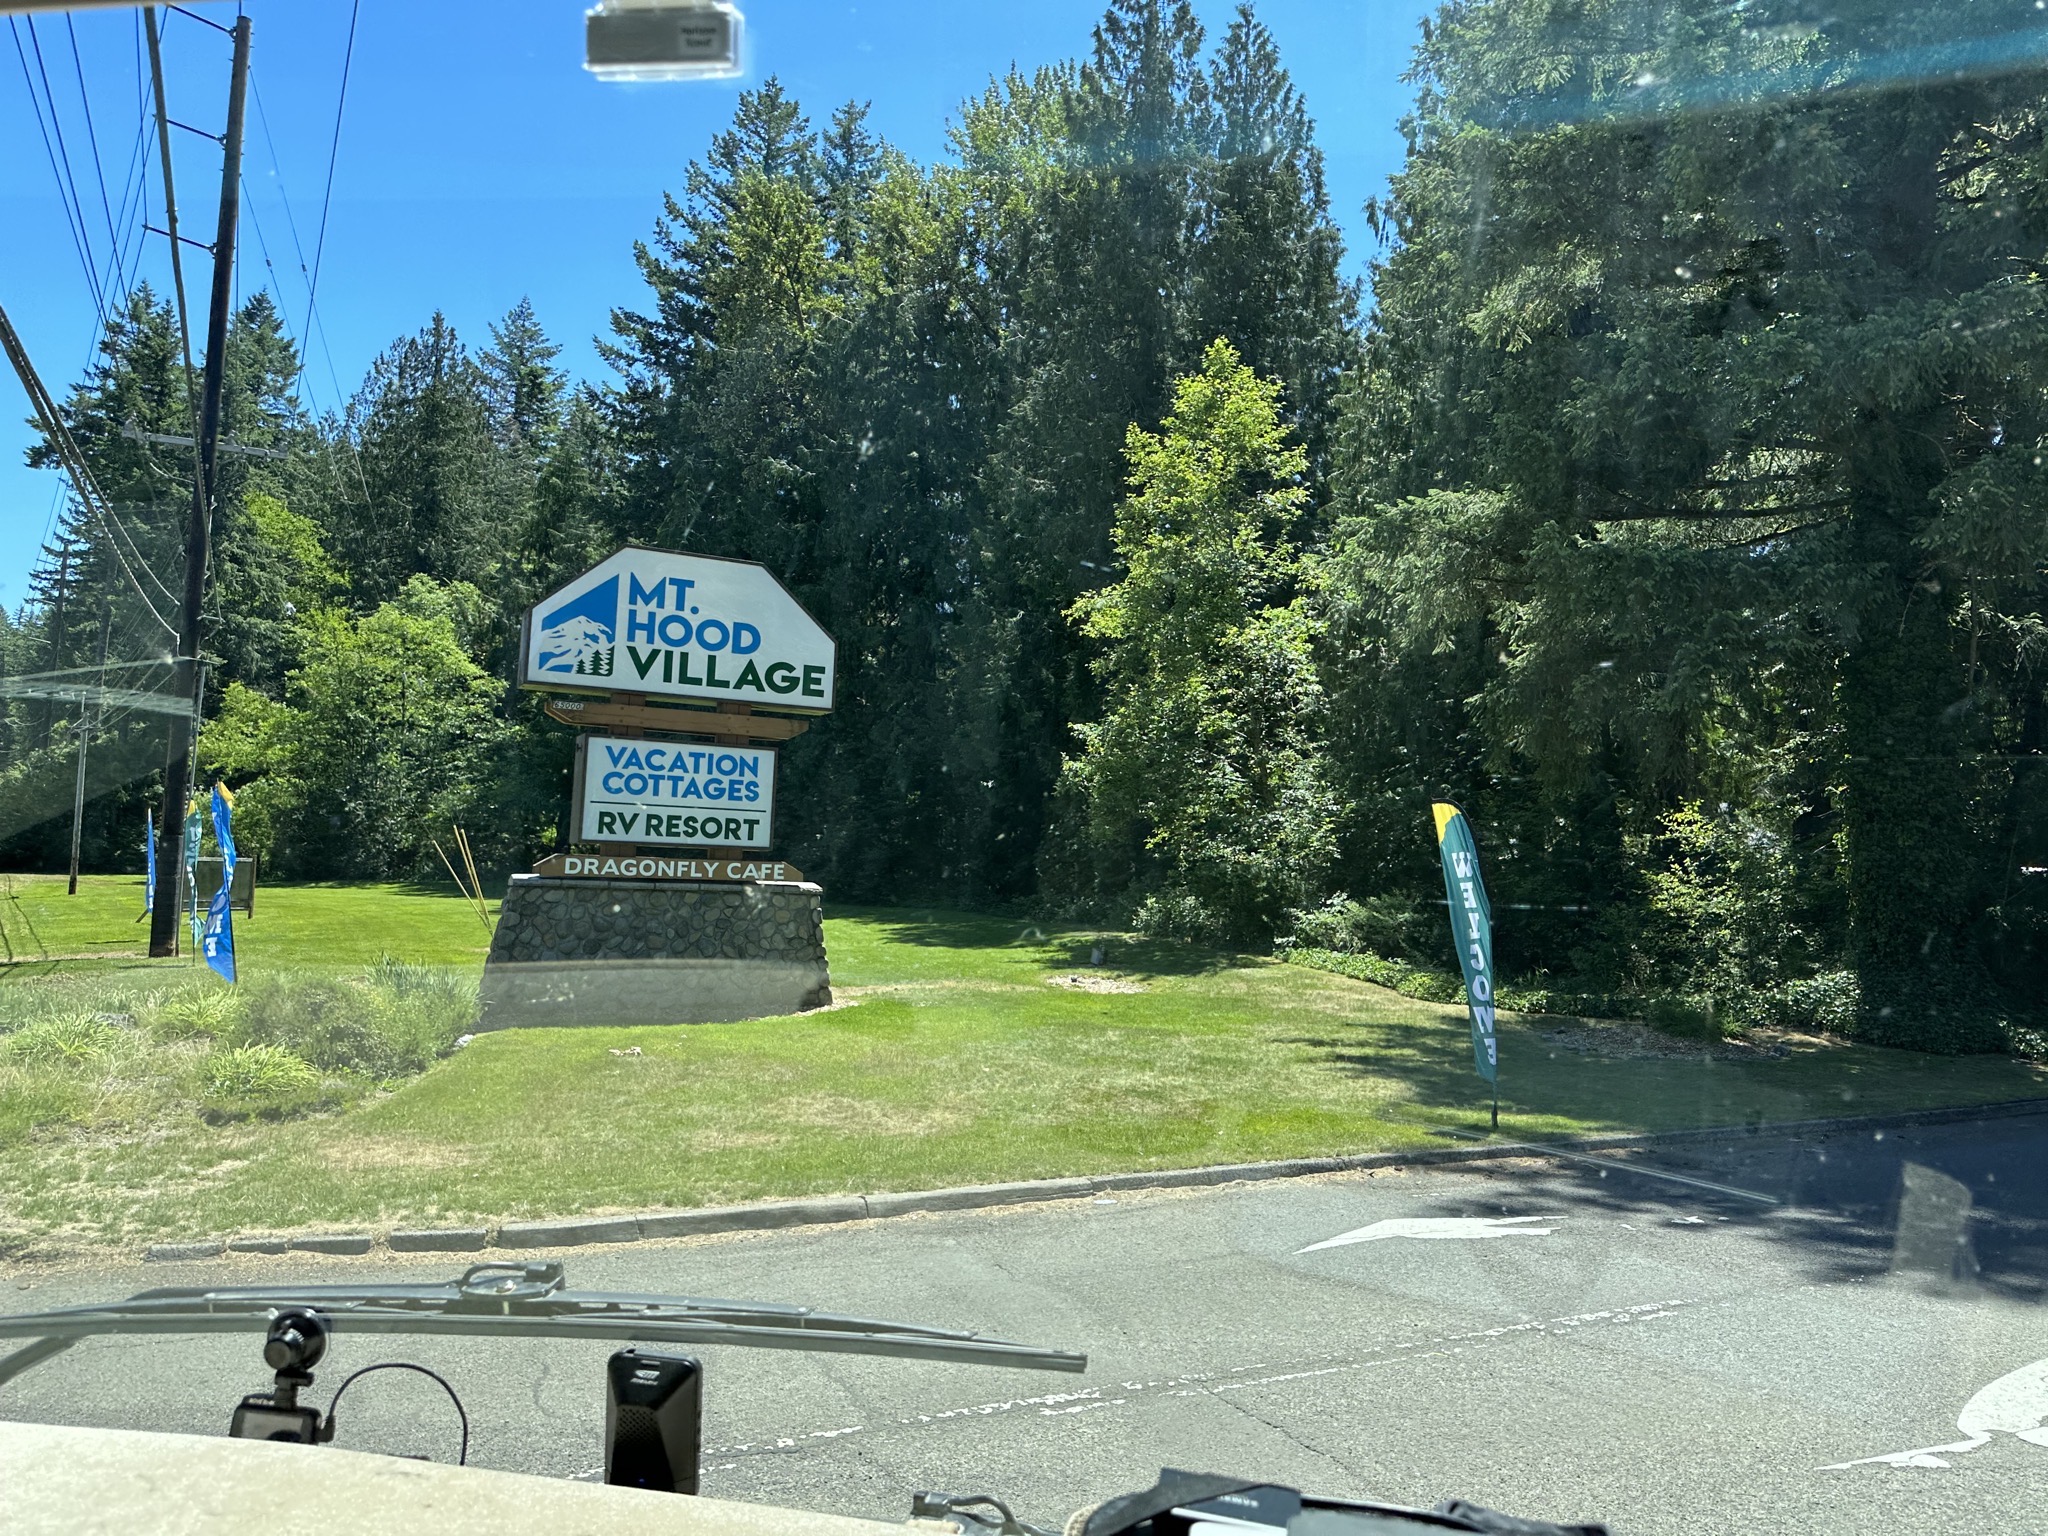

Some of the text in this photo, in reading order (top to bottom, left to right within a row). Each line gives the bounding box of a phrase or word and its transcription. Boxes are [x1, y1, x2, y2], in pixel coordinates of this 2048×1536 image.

[629, 571, 700, 615] MT.
[626, 609, 762, 655] HOOD
[626, 646, 827, 698] VILLAGE
[554, 701, 582, 710] 65000
[605, 745, 760, 778] VACATION
[602, 772, 760, 802] COTTAGES
[597, 811, 760, 841] RV RESORT
[564, 857, 785, 880] DRAGONFLY CAFE
